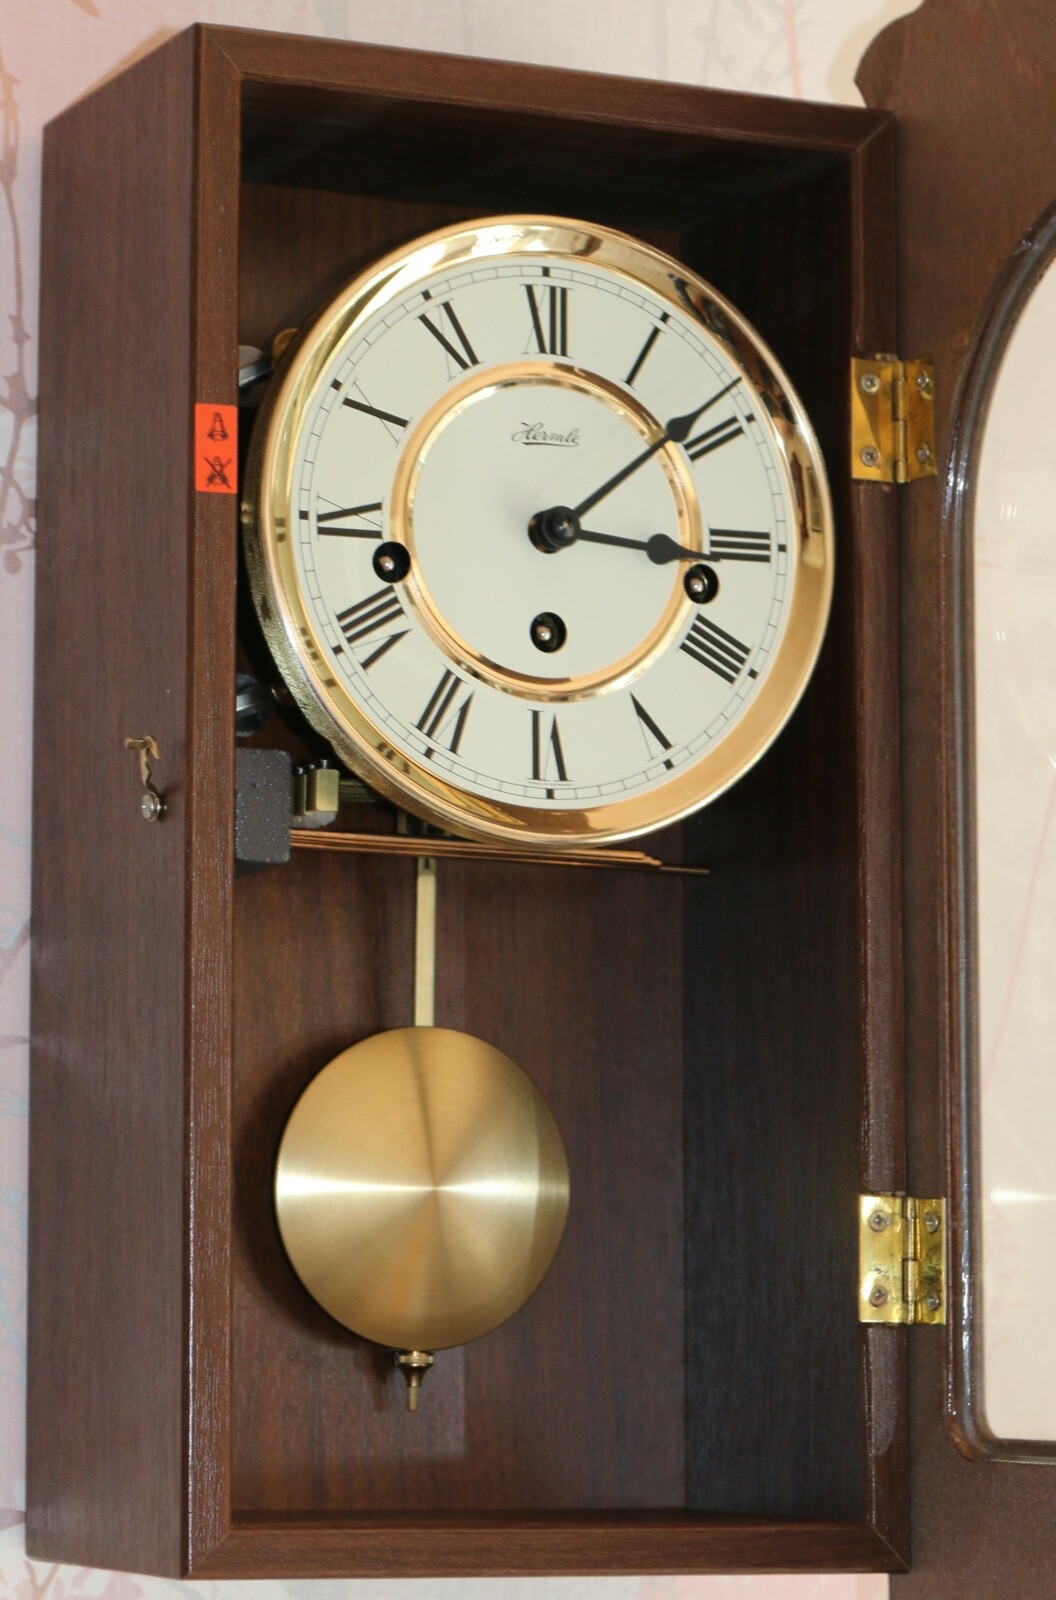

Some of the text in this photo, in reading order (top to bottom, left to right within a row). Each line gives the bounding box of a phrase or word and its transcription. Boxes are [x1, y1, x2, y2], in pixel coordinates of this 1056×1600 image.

[414, 299, 485, 381] XI
[520, 284, 574, 359] XII
[621, 322, 667, 391] I
[340, 378, 413, 448] X
[511, 422, 580, 447] Hermle
[681, 409, 748, 468] II
[316, 491, 384, 542] IX
[707, 524, 772, 570] III
[333, 584, 413, 676] VIII
[677, 611, 755, 688] IIII
[410, 664, 476, 757] VII
[527, 709, 575, 781] VI
[630, 691, 678, 762] V
